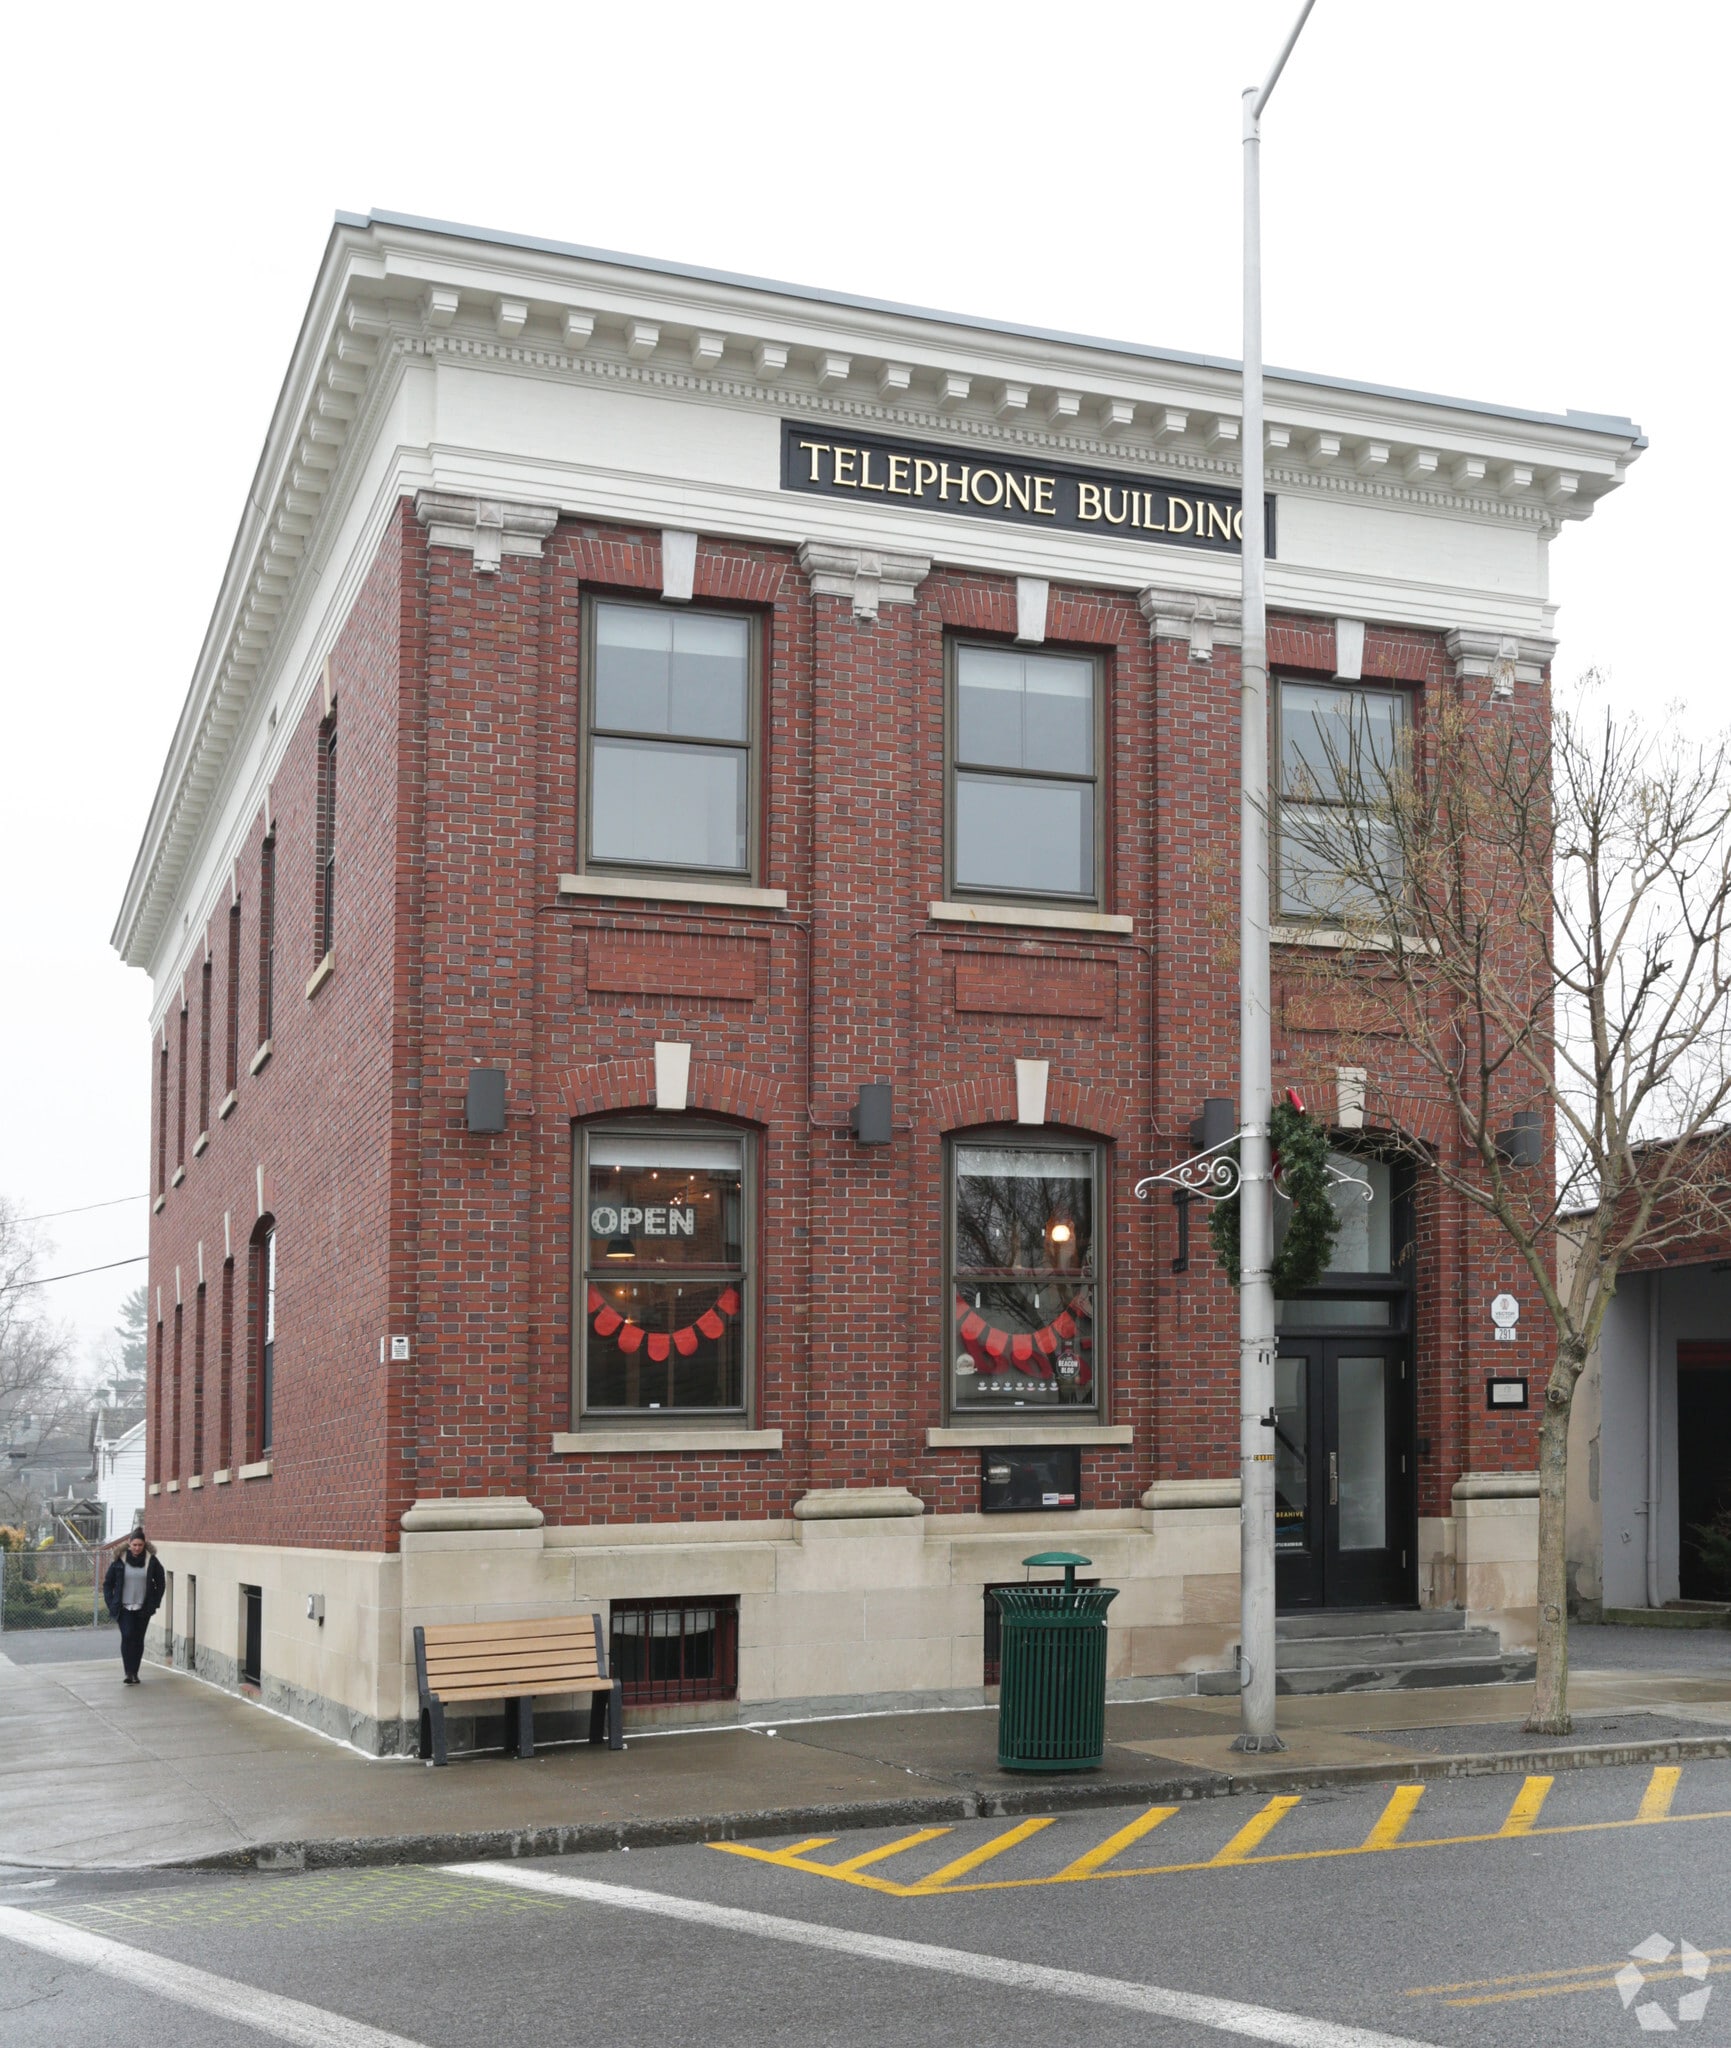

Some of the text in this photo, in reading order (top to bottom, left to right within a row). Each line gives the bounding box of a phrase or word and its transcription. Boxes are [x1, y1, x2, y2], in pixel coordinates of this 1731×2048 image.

[799, 440, 1057, 516] TELEPHONE
[591, 1207, 694, 1235] OPEN
[1499, 1328, 1511, 1339] 291
